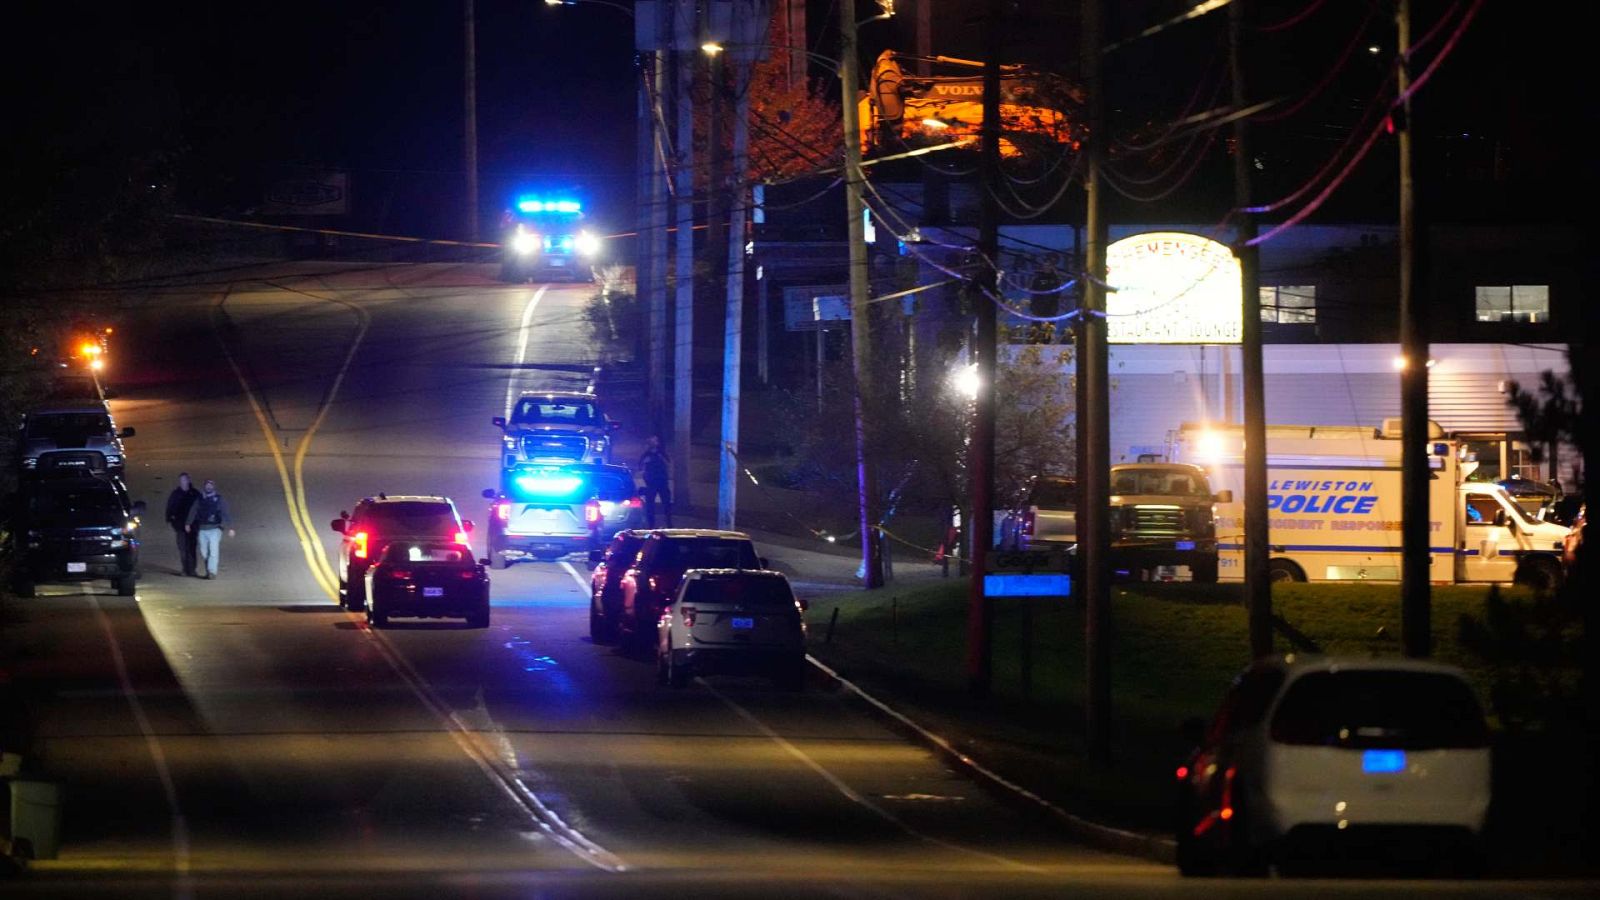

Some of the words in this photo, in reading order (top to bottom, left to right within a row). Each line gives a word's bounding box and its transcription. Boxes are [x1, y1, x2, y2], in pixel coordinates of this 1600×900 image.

[935, 85, 984, 96] VOLV
[1269, 479, 1374, 492] LEWISTON
[1267, 494, 1379, 514] POLICE
